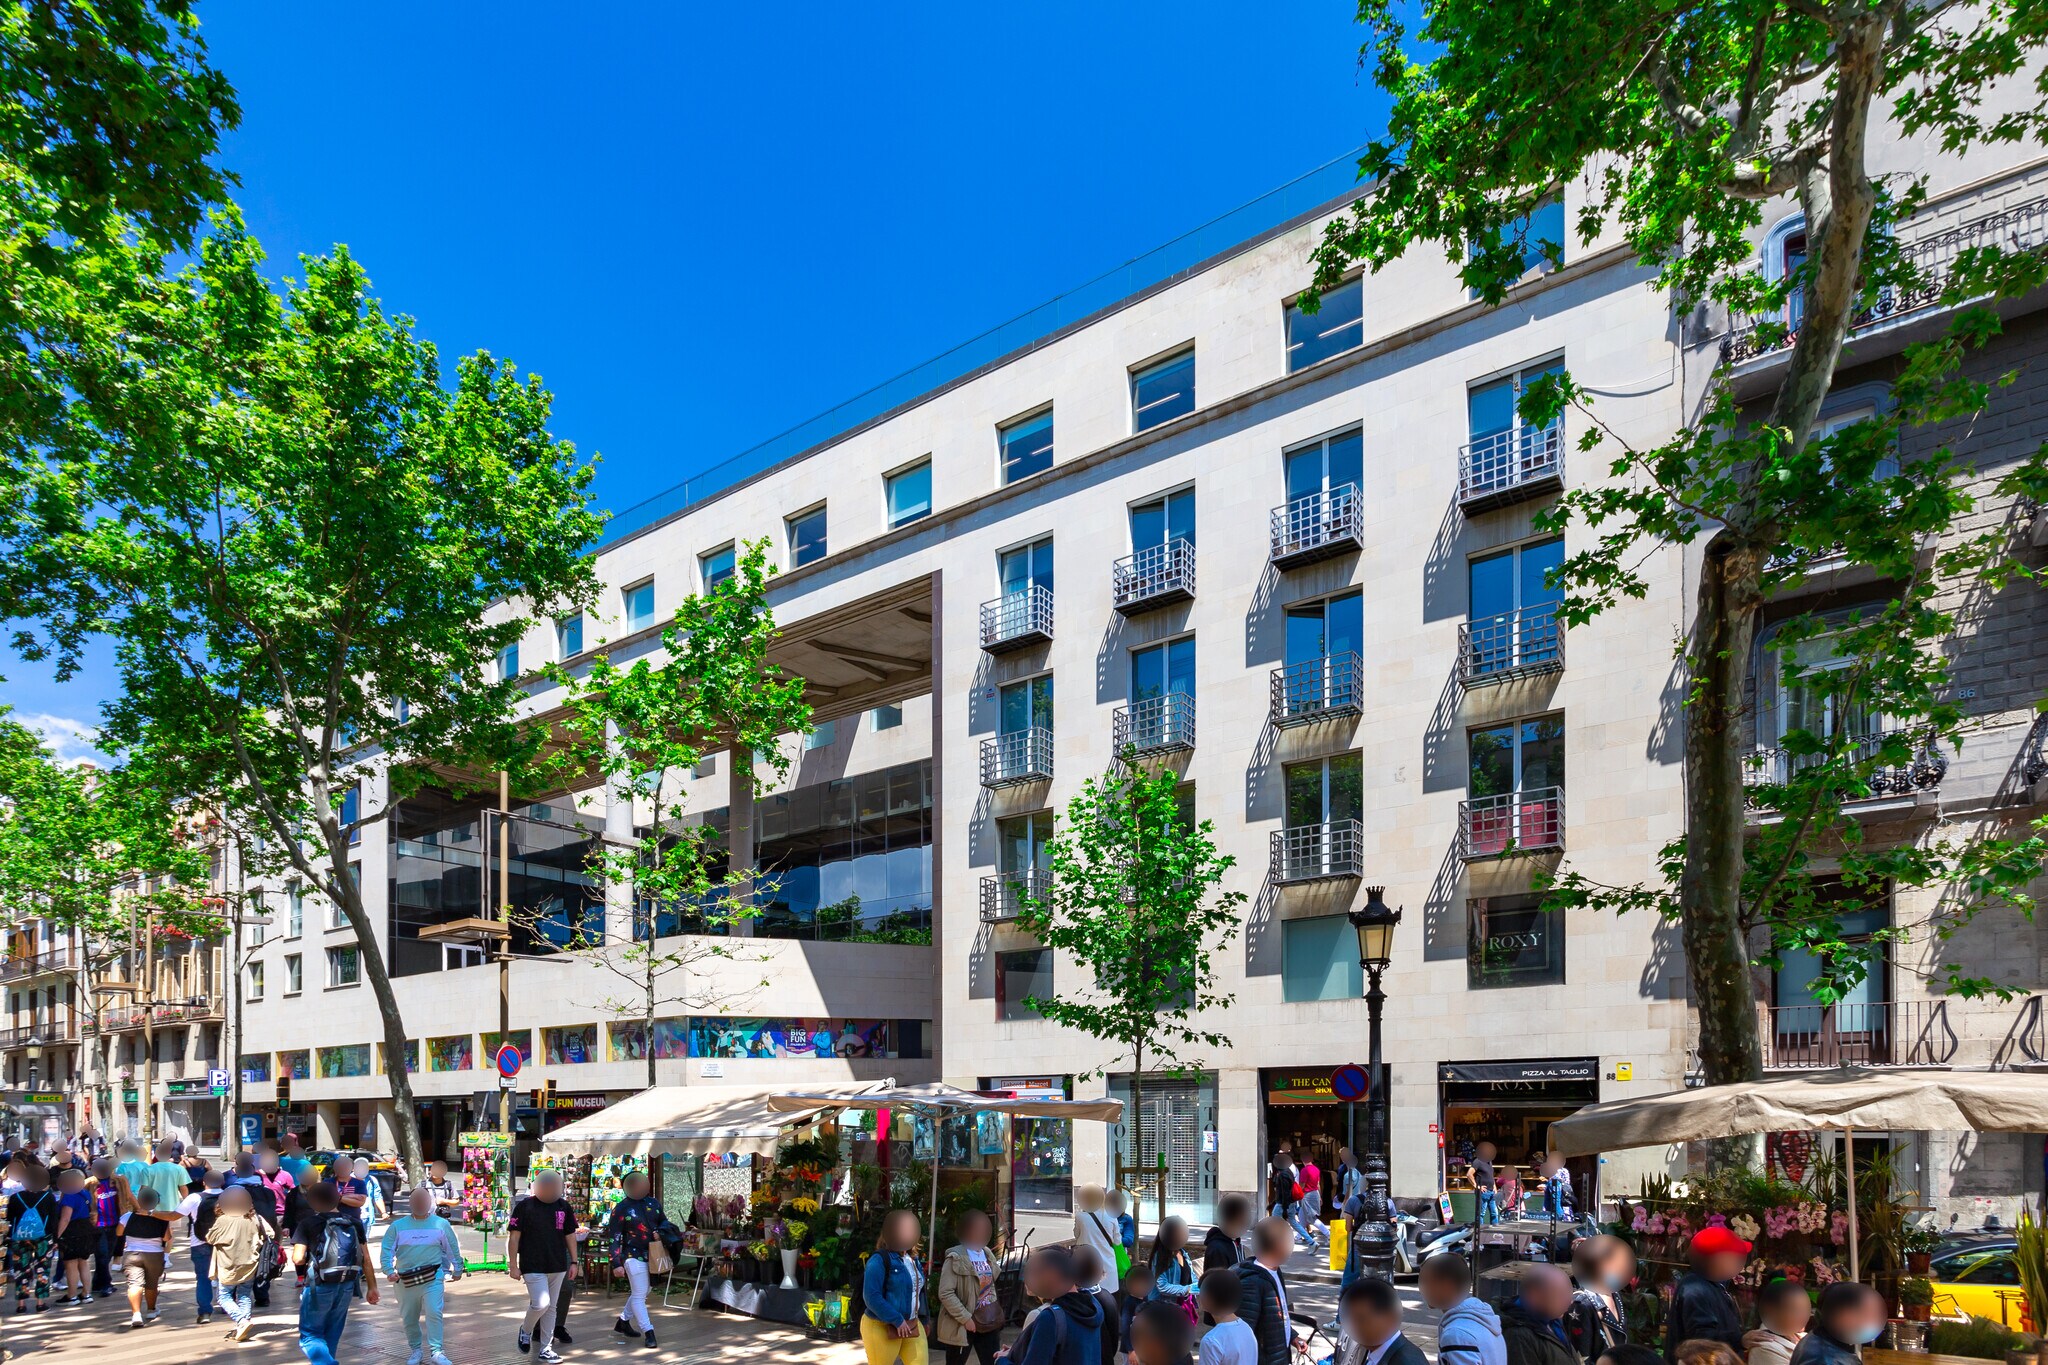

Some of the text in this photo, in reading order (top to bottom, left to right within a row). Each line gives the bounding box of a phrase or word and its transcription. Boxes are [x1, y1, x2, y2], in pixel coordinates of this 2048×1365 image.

[1489, 932, 1542, 950] ROXY
[790, 1028, 806, 1036] BIG
[1292, 1078, 1310, 1087] THE
[557, 1098, 574, 1108] FUN
[1204, 1106, 1217, 1189] TOCH
